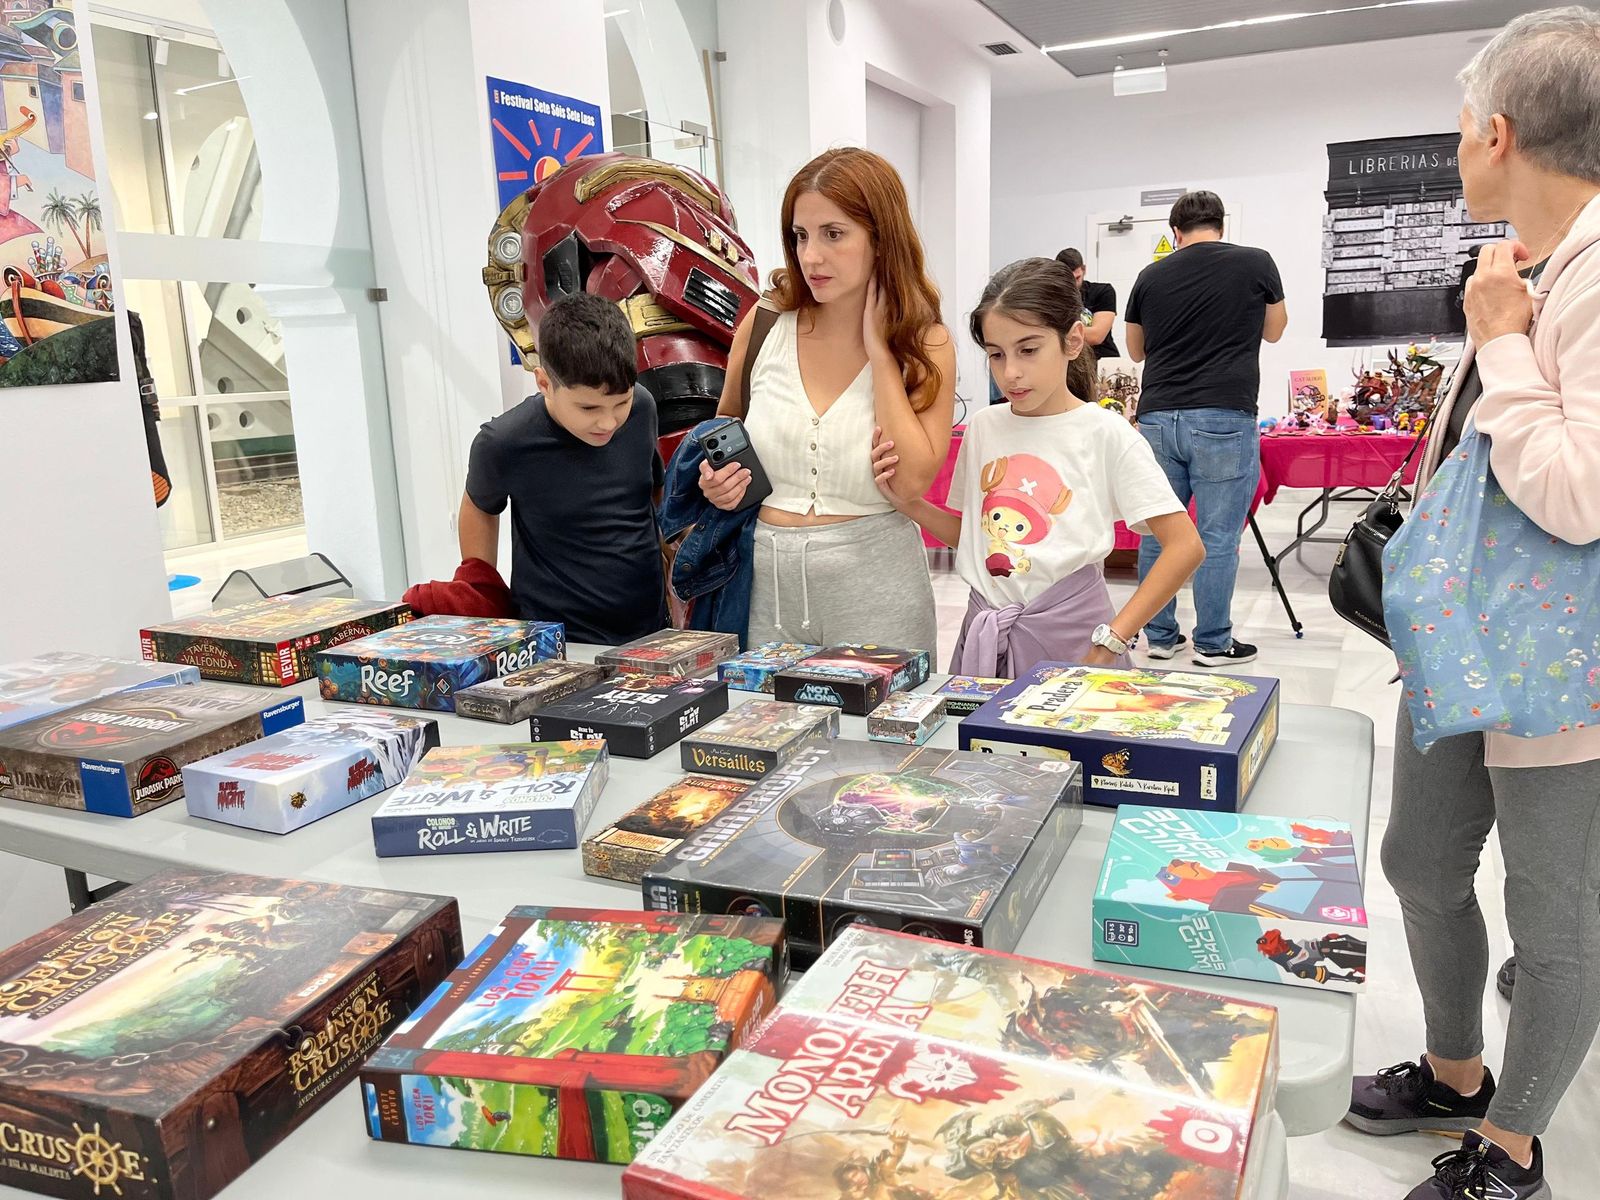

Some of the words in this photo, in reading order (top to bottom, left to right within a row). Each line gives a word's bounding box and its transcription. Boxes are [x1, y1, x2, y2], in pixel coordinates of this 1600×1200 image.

[500, 91, 533, 111] Festival
[534, 98, 550, 115] Sete
[566, 106, 581, 122] Sete
[581, 111, 596, 127] Luas
[1349, 152, 1439, 174] LIBRERIAS
[142, 638, 154, 661] EVIR
[186, 644, 229, 659] TAVERNE
[327, 627, 371, 647] TABERNAS
[280, 647, 293, 679] DEVIR
[496, 640, 537, 677] Reef
[361, 664, 415, 697] Reef
[806, 685, 830, 695] NOT
[1027, 680, 1084, 713] Pradera
[263, 700, 301, 720] Ravensburger
[800, 692, 838, 703] ALONE
[81, 761, 121, 775] Ravensburger
[691, 746, 766, 773] Versailles
[135, 781, 165, 801] JURASSIC
[164, 773, 183, 790] PARK
[501, 780, 576, 796] ROLL
[729, 746, 831, 817] PROJECT
[386, 788, 474, 808] WRITE
[417, 829, 465, 850] ROLL
[466, 822, 478, 838] &
[479, 815, 532, 837] WRITE
[426, 817, 456, 827] COLONOS
[1120, 817, 1199, 858] WILD
[1145, 809, 1228, 859] SPACE
[43, 938, 73, 958] IGNACY
[1179, 925, 1213, 969] WILD
[1192, 915, 1226, 972] SPACE
[7, 911, 192, 1011] CRUSOE
[36, 979, 98, 1018] AVENTURAS
[95, 971, 111, 980] EN
[109, 961, 126, 972] LA
[125, 950, 146, 966] ISLA
[144, 924, 189, 951] MALDITA
[450, 979, 470, 999] SCOTT
[469, 957, 493, 980] CAPUTO
[476, 984, 506, 1008] LOS
[505, 952, 538, 977] CIEN
[504, 960, 560, 1001] TORII
[331, 996, 349, 1017] IGNACY
[288, 979, 380, 1073] ROBINSON
[294, 1000, 393, 1092] CRUSOE
[814, 997, 933, 1119] ARENA
[299, 1075, 333, 1109] AVENTURAS
[332, 1068, 341, 1080] EN
[339, 1063, 348, 1074] LA
[347, 1053, 361, 1069] ISLA
[360, 1033, 383, 1057] MALDITA
[380, 1092, 391, 1121] SCOTT
[388, 1089, 401, 1126] CAPUTO
[412, 1088, 422, 1109] CIEN
[423, 1094, 436, 1125] TORII
[415, 1113, 424, 1131] LOS
[0, 1122, 145, 1195] CRUSOE
[8, 1158, 29, 1171] ISLA
[30, 1164, 72, 1181] MALDITA
